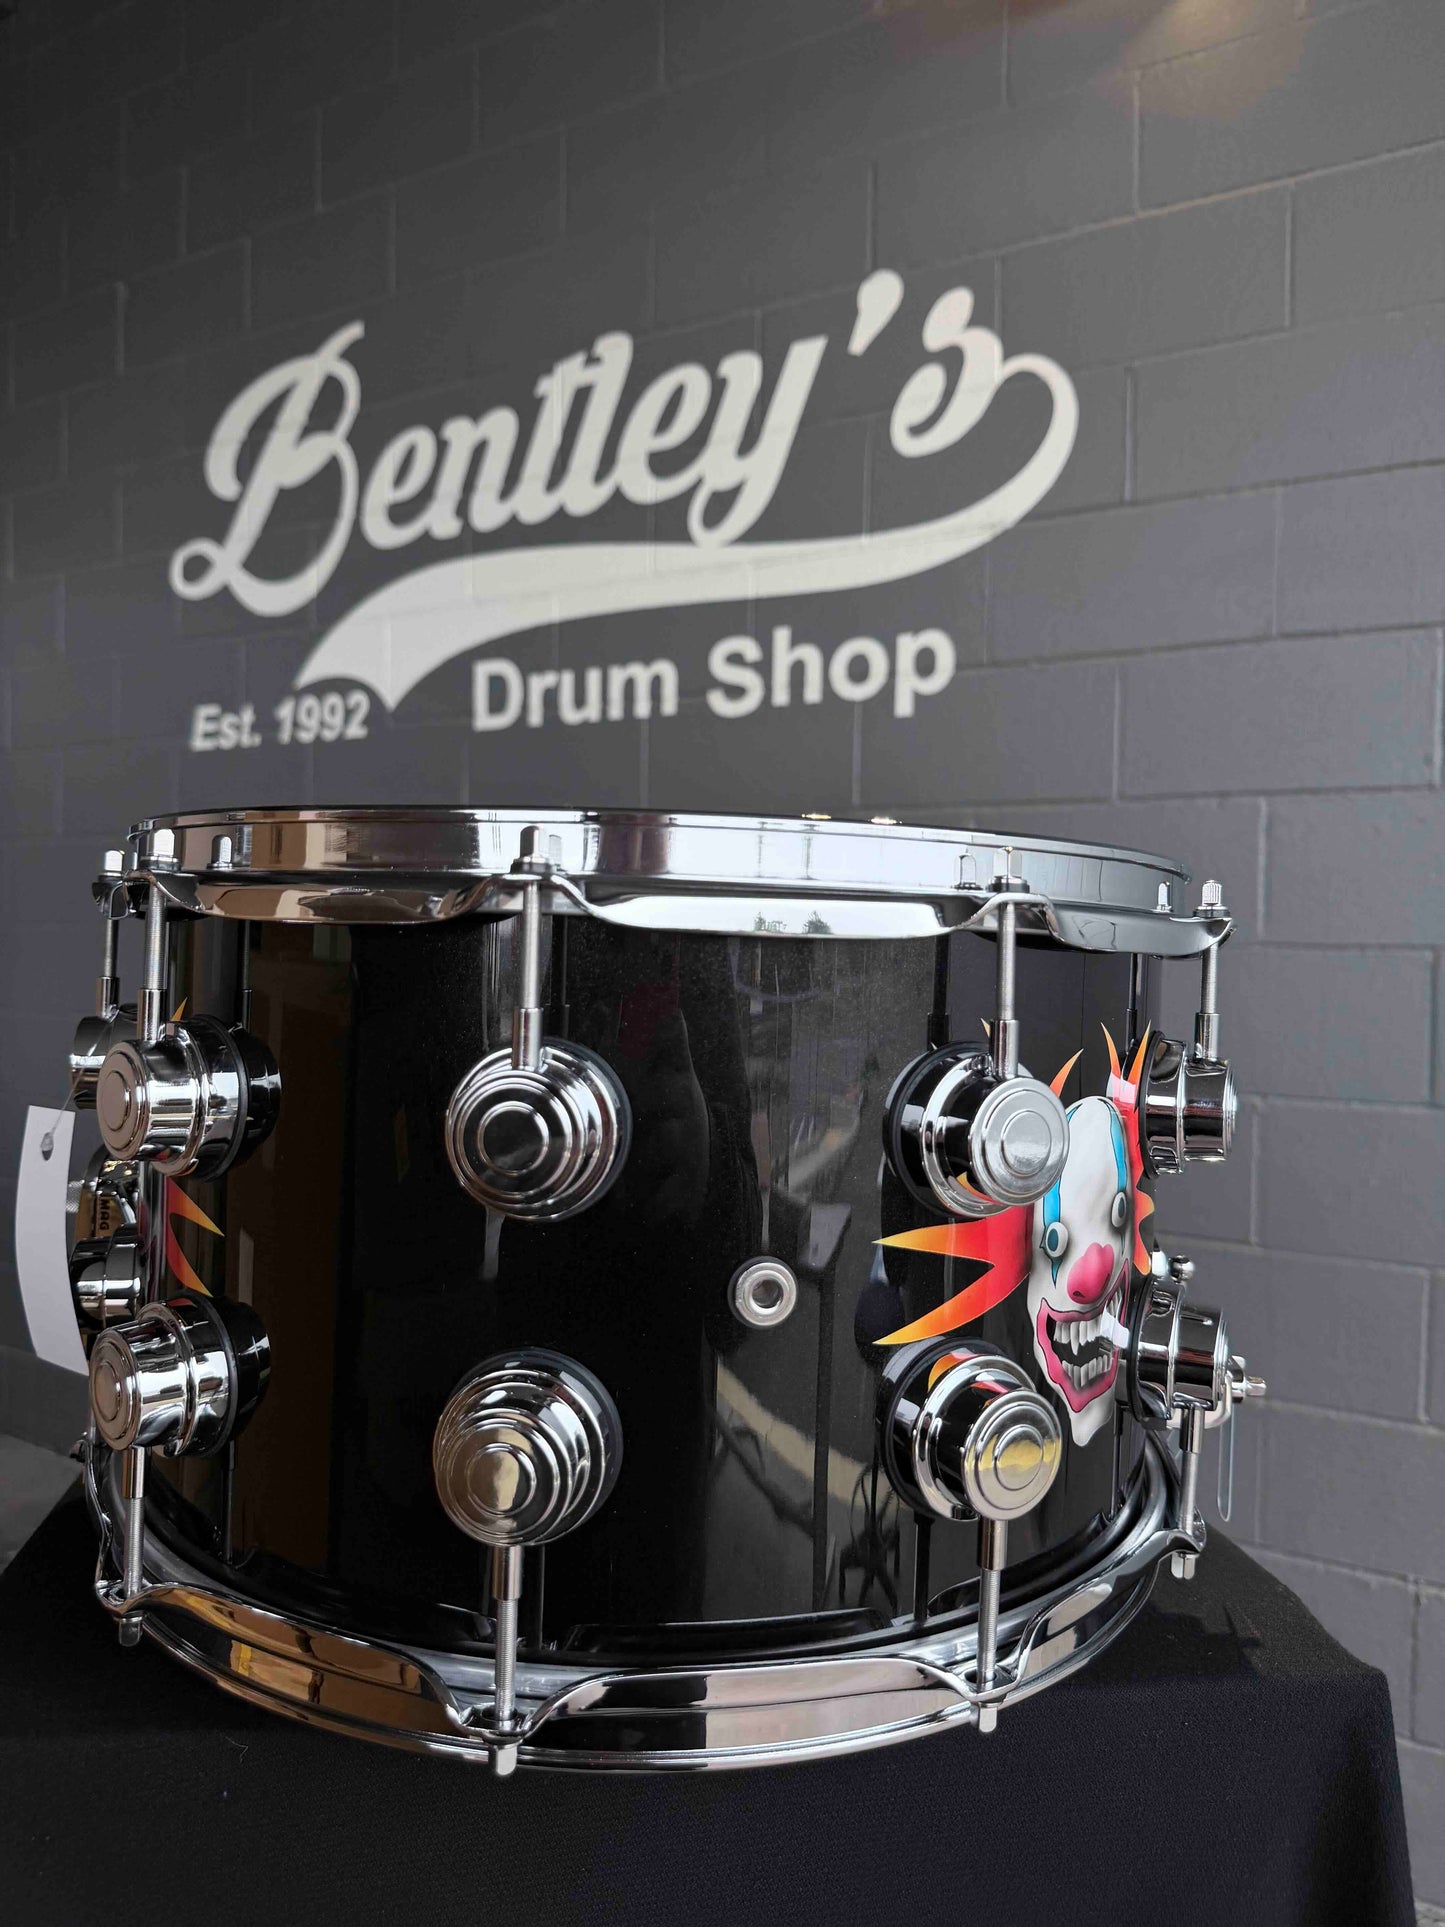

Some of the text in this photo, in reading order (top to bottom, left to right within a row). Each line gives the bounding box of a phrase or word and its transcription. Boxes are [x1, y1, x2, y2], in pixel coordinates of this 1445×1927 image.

[169, 269, 1080, 616] Bentley's
[190, 690, 370, 752] Est. 1992
[472, 626, 957, 732] Drum Shop
[100, 1199, 110, 1230] MAG
